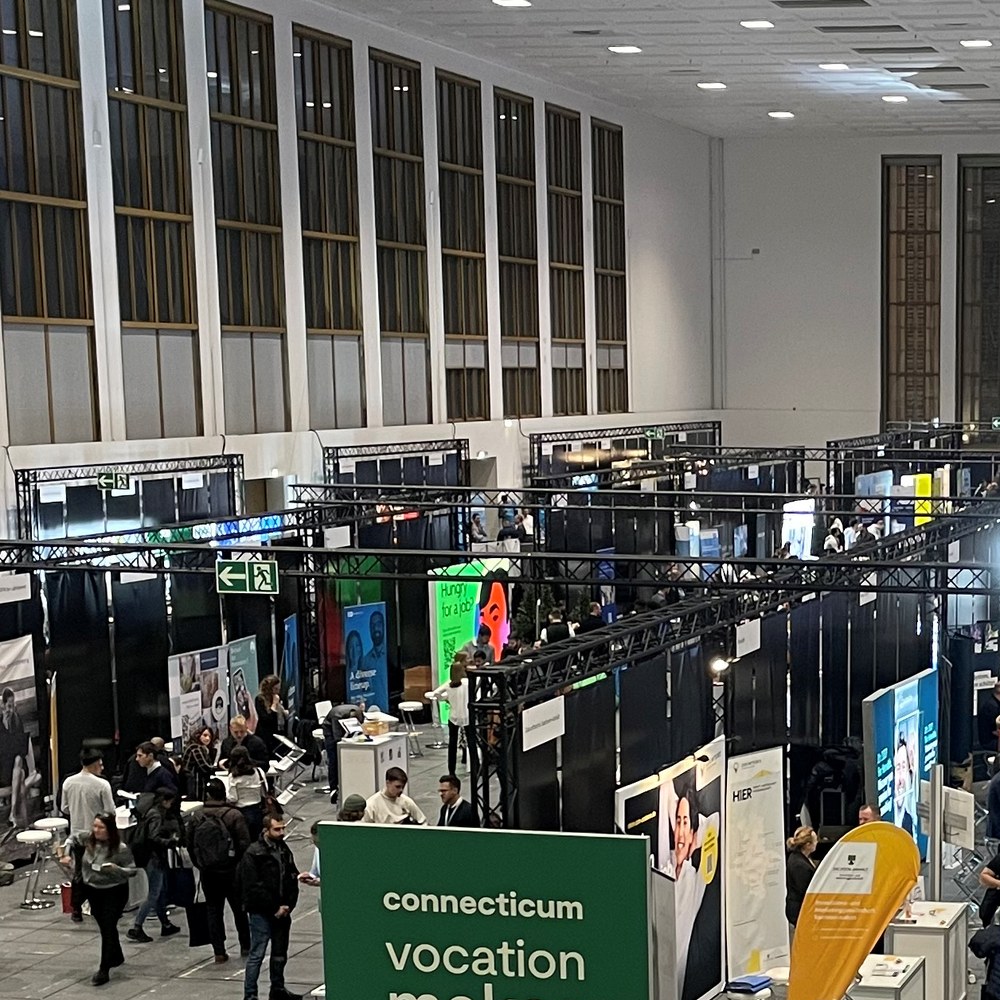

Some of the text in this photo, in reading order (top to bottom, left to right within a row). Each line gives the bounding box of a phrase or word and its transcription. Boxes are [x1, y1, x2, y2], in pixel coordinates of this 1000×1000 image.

[441, 583, 467, 599] Hungry
[442, 596, 475, 618] for a job?
[733, 788, 752, 802] HIER
[383, 890, 584, 920] connecticum
[385, 939, 586, 981] vocation
